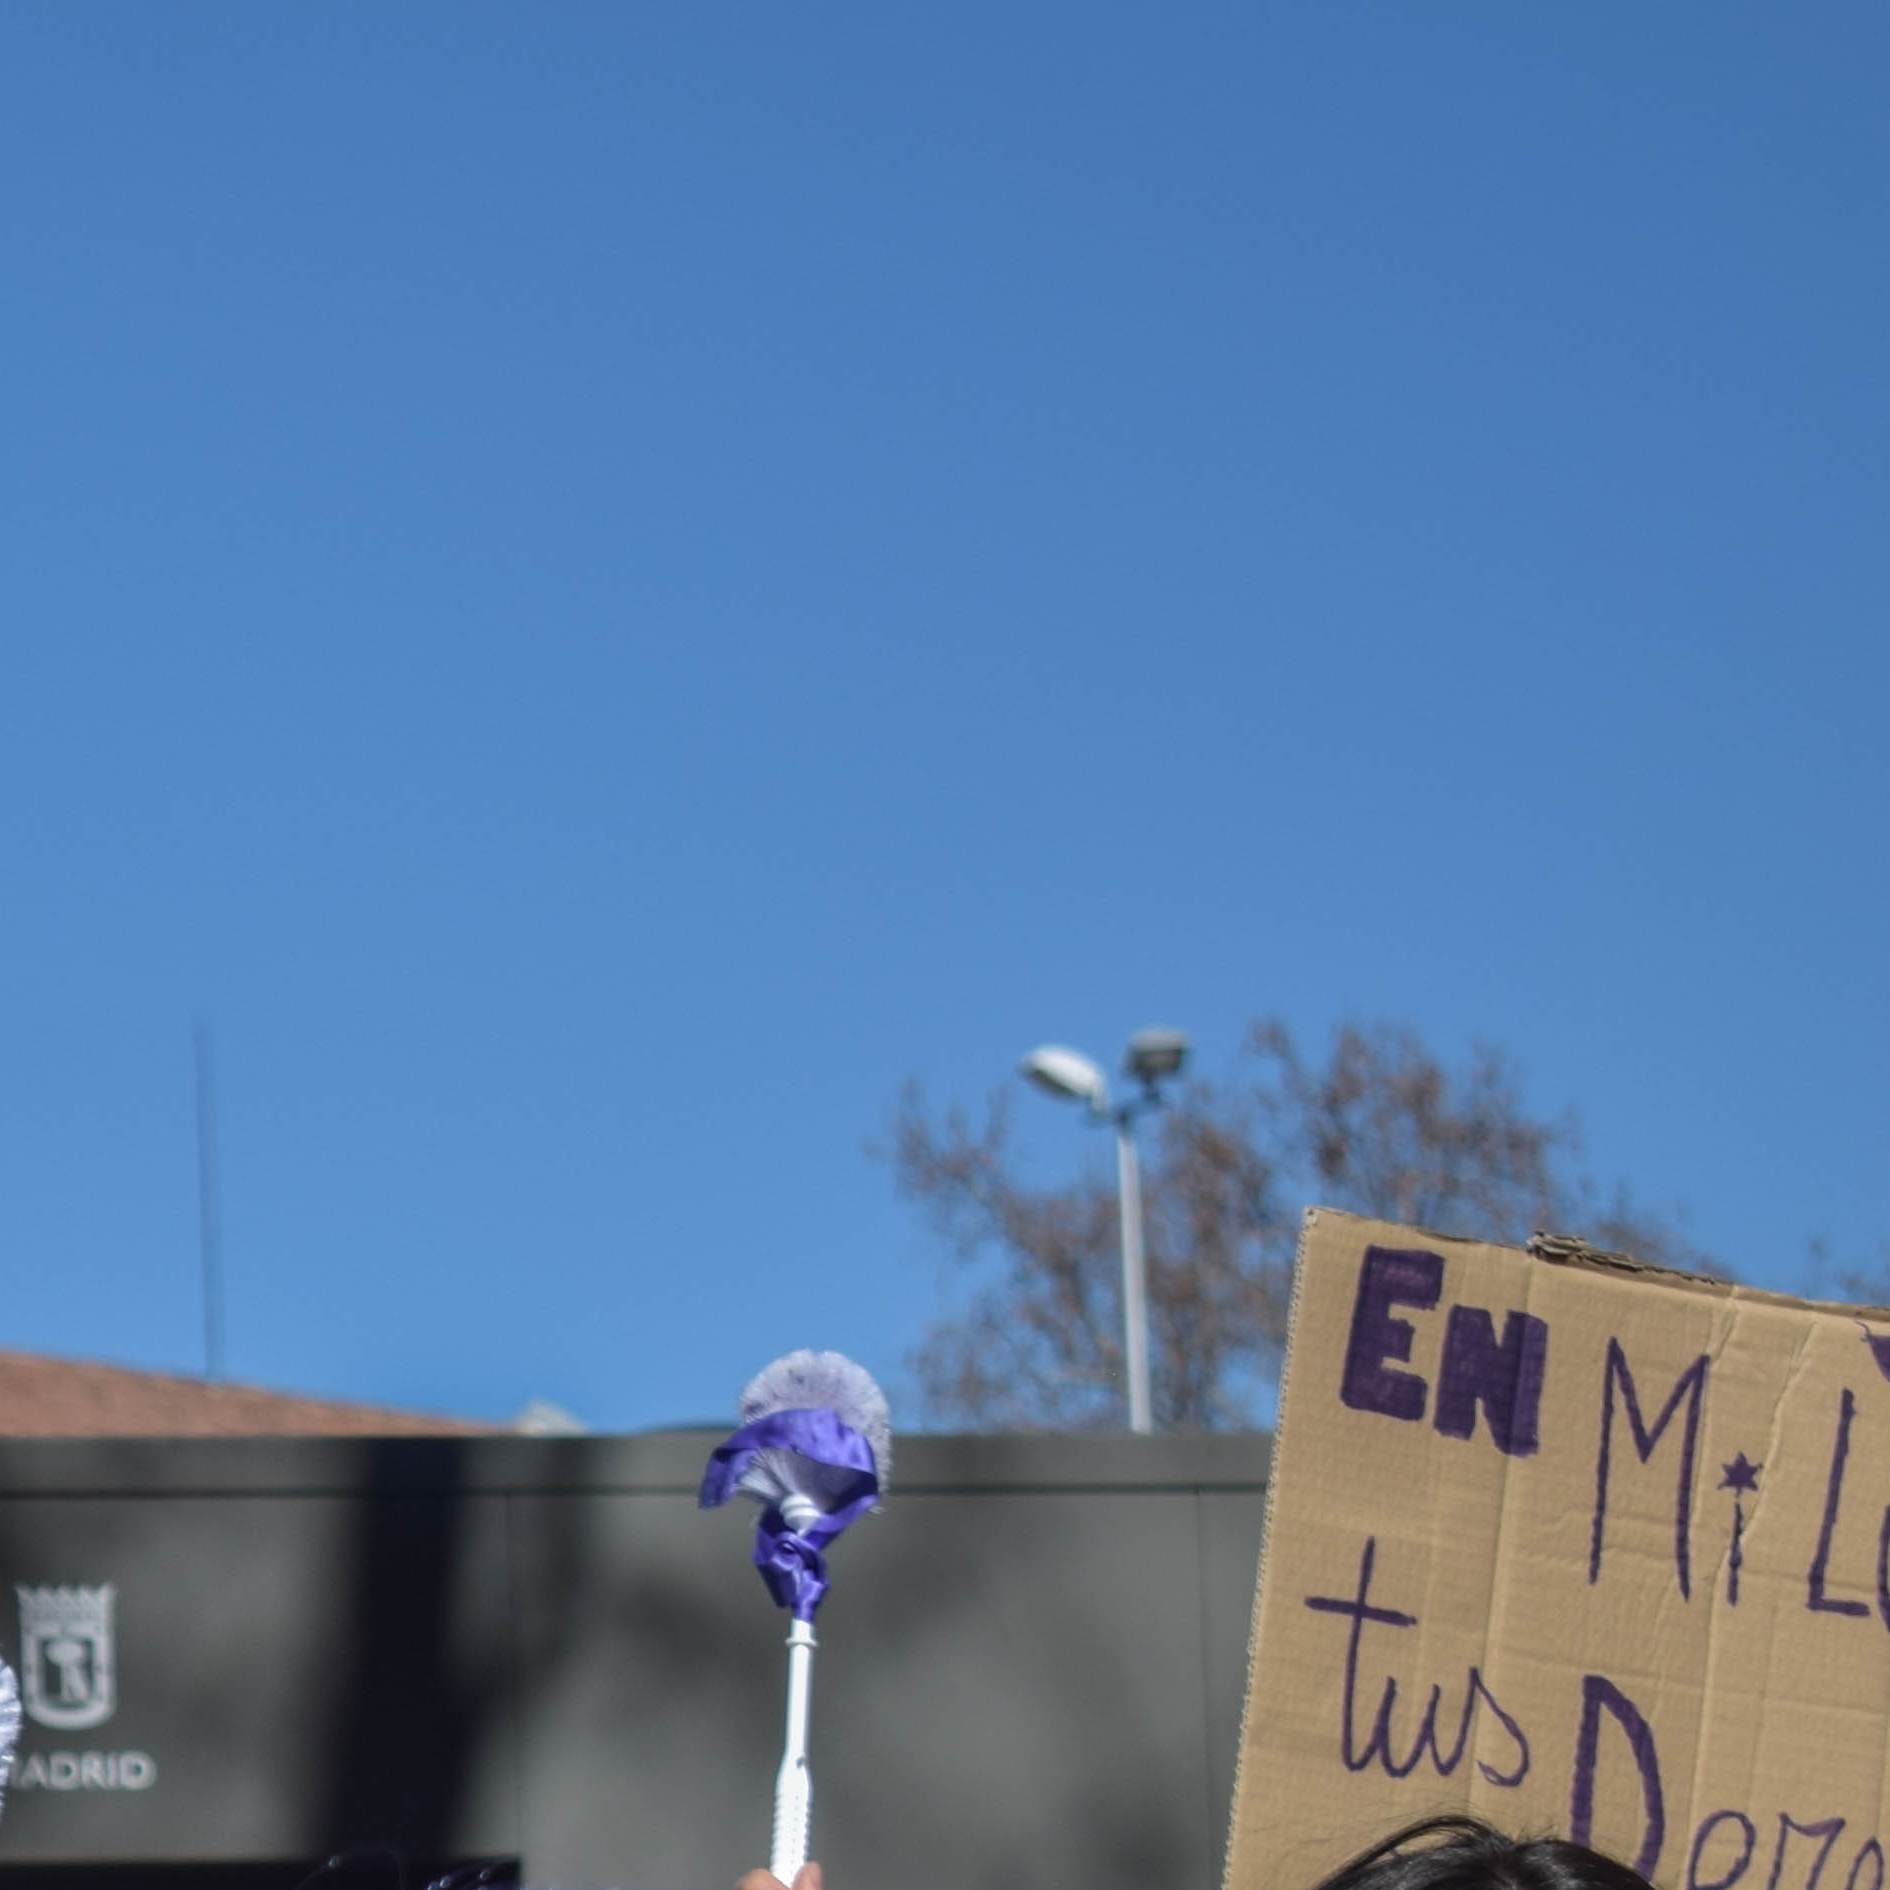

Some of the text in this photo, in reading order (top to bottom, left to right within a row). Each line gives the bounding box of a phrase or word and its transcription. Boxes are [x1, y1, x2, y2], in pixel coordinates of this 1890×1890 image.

[1340, 1245, 1890, 1636] EN MiL
[9, 1751, 157, 1791] ADRID
[1304, 1537, 1530, 1787] tus
